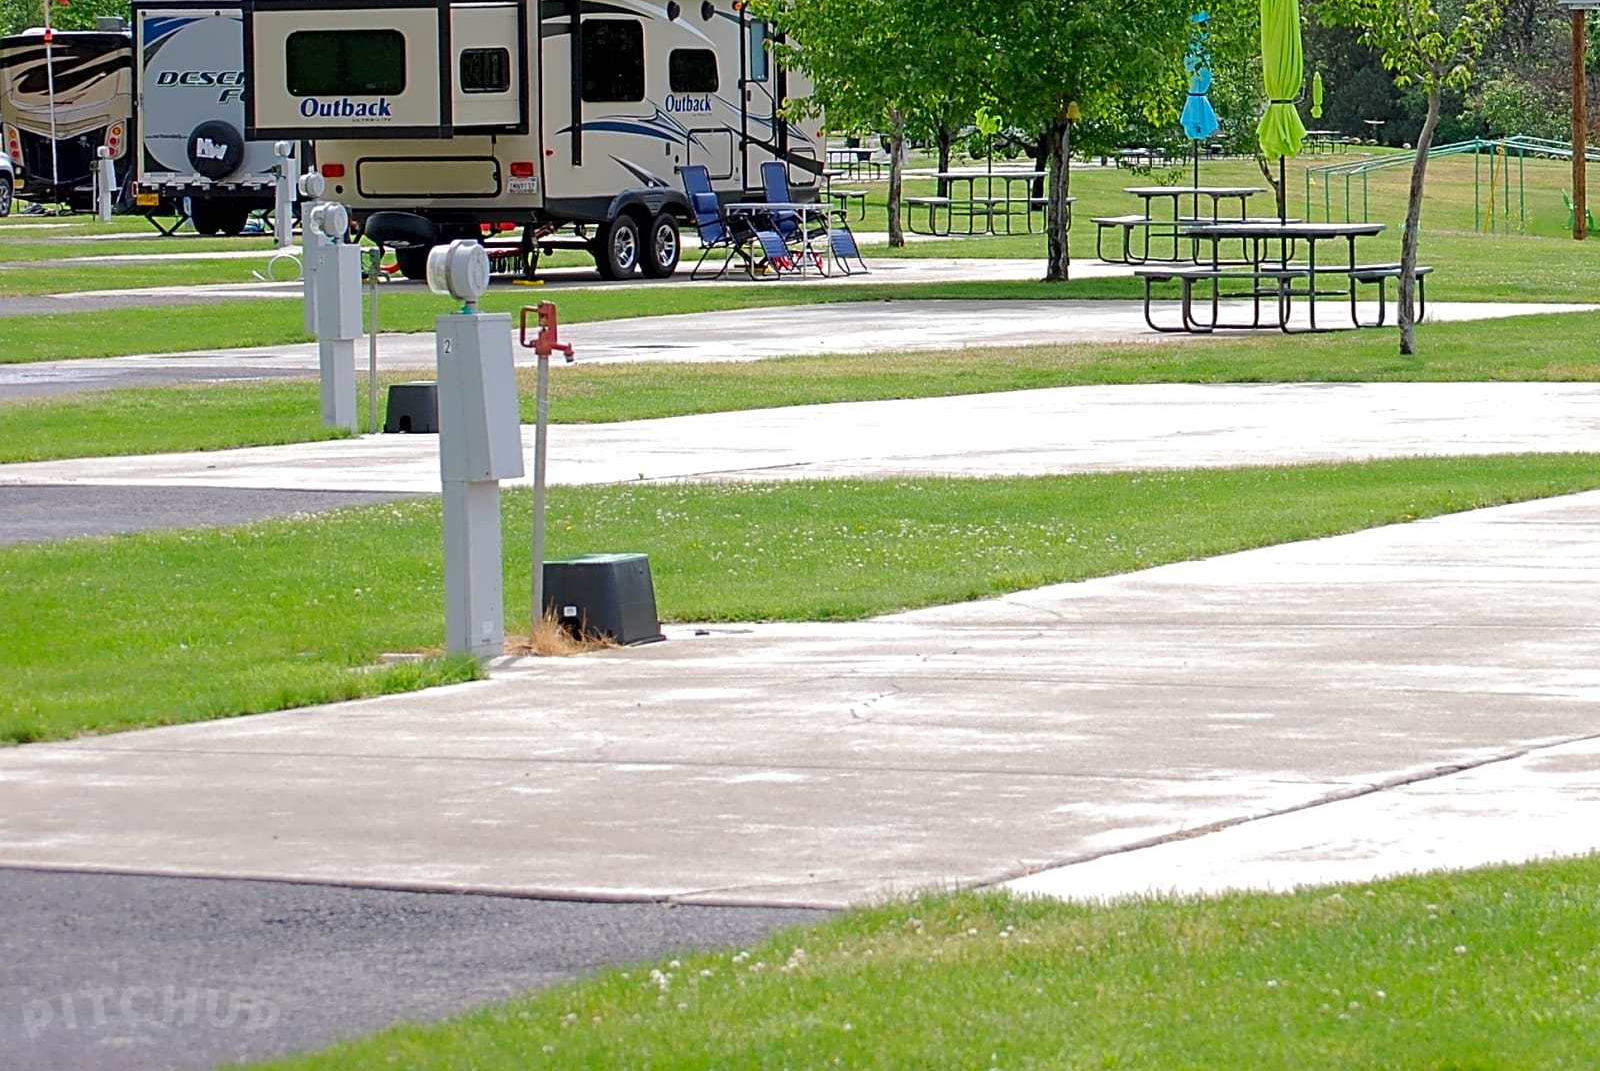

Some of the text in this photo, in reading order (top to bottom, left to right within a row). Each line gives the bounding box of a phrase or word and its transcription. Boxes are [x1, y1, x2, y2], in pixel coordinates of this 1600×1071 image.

[300, 97, 392, 117] Outback
[665, 93, 712, 112] Outback
[444, 339, 451, 354] 2
